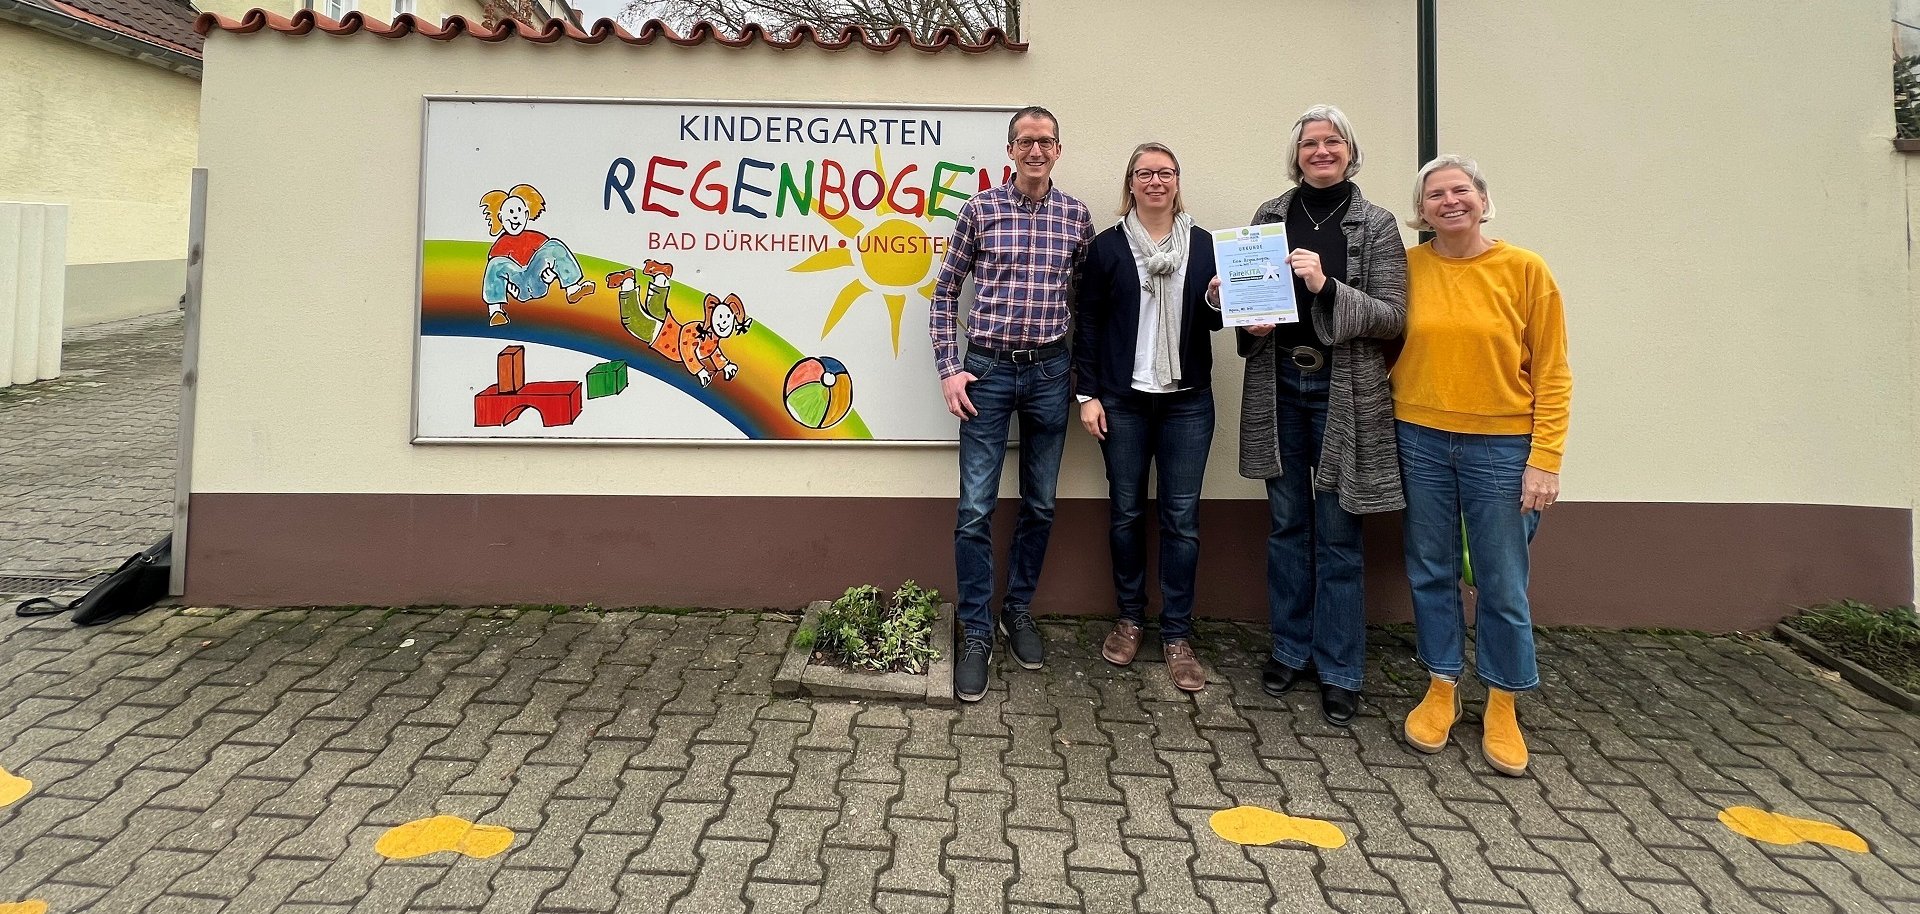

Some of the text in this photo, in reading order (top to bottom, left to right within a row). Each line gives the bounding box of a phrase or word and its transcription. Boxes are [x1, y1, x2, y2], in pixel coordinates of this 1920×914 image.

[680, 115, 941, 146] KINDERGARTEN
[648, 232, 696, 250] BAD
[705, 229, 828, 252] DÜRKHEIM
[1229, 268, 1261, 277] FaireKITA
